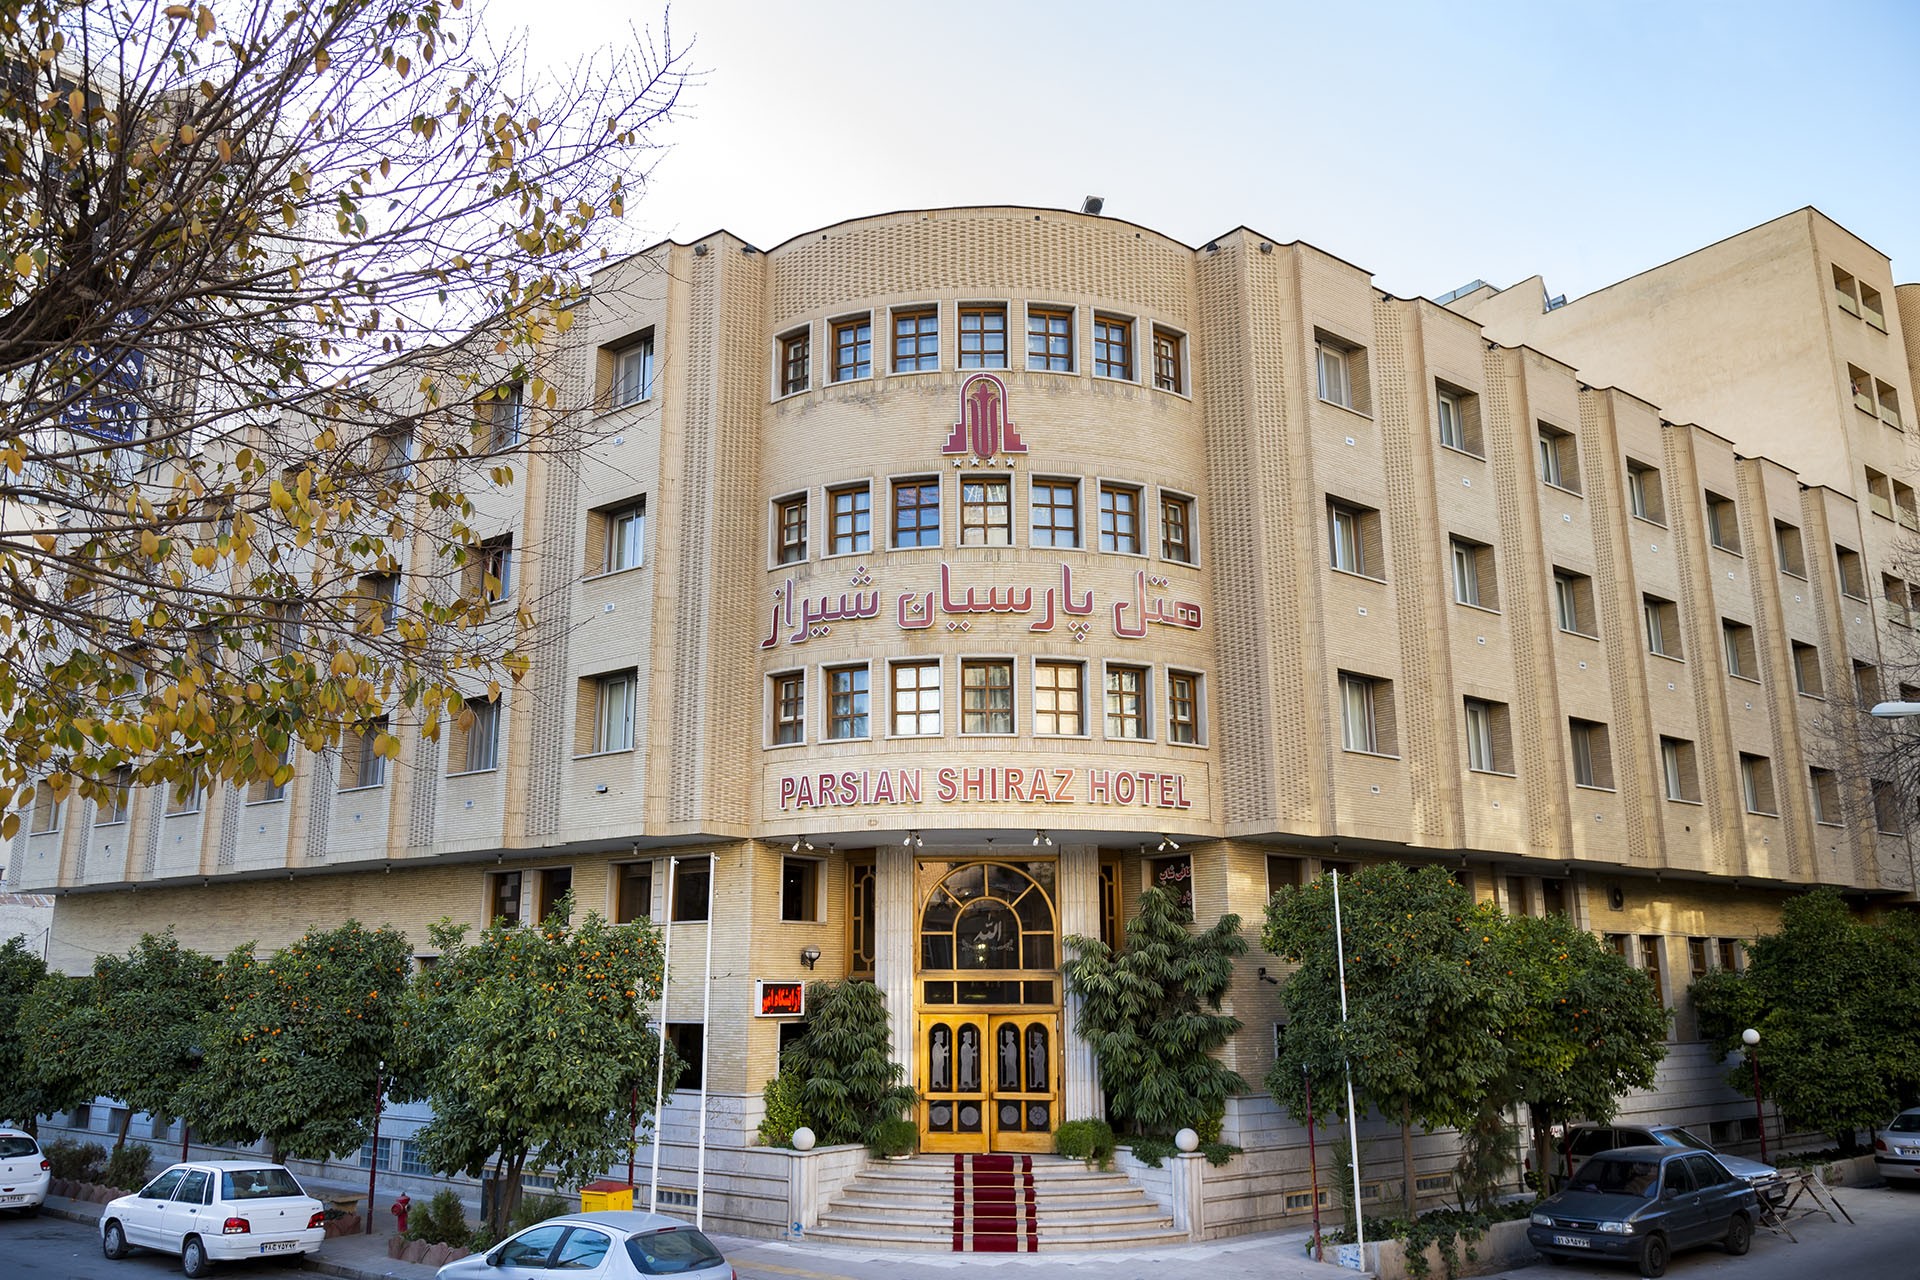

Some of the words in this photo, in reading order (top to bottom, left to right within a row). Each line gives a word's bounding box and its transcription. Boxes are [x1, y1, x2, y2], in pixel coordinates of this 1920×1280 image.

[760, 564, 880, 649] شیراز
[897, 562, 1094, 643] پارسیان
[1113, 569, 1203, 638] هتل
[780, 767, 922, 810] PARSIAN
[937, 767, 1076, 804] SHIRAZ
[1089, 769, 1192, 809] HOTEL
